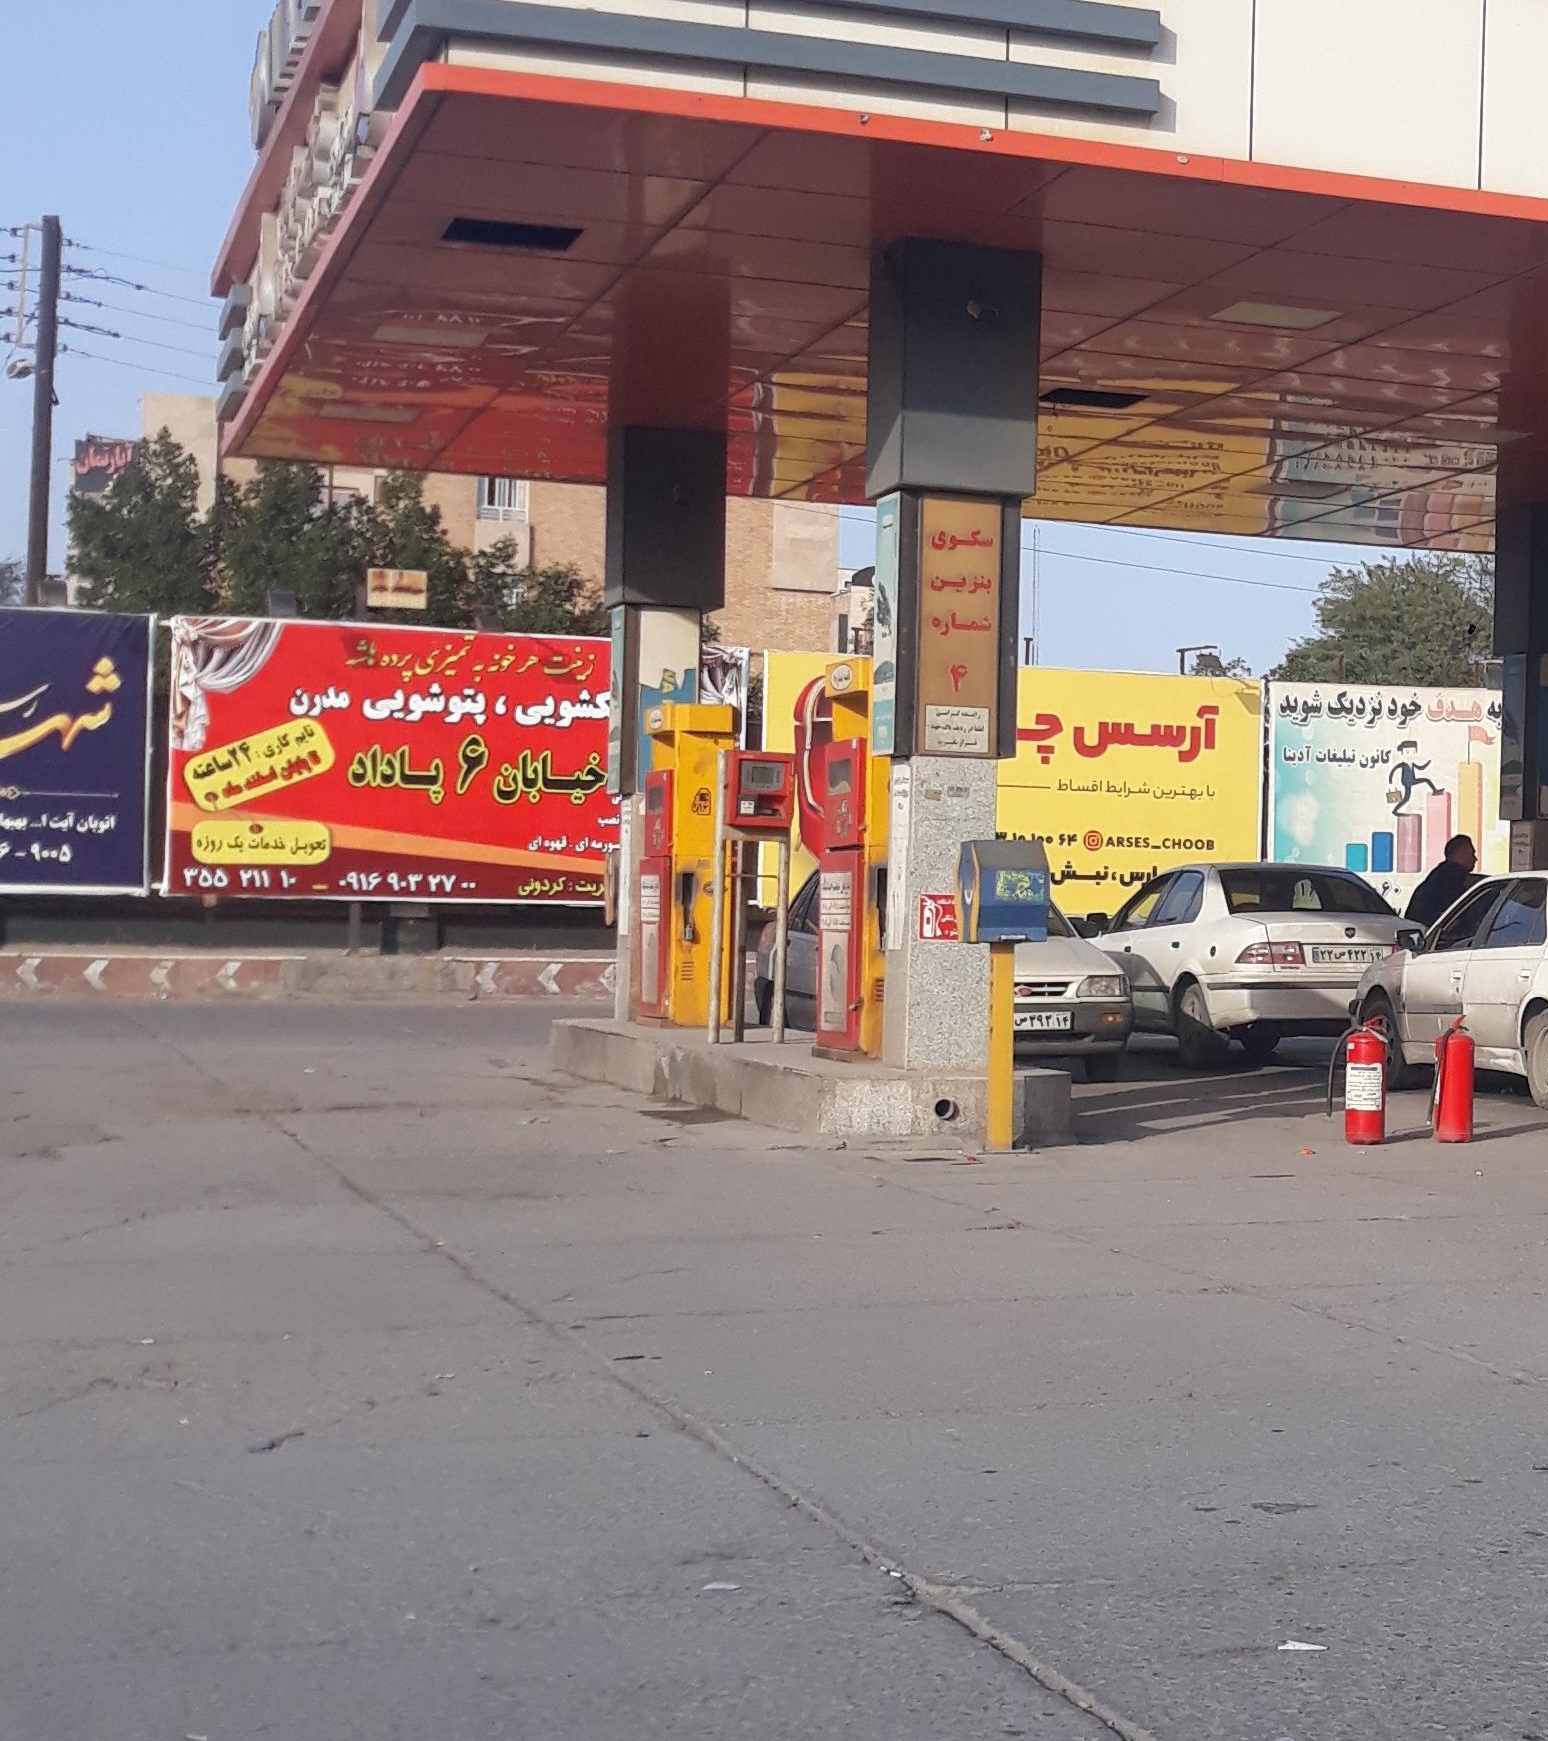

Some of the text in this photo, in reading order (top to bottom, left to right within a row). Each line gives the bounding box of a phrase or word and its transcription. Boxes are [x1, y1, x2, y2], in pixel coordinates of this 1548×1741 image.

[930, 573, 992, 595] بنزین
[931, 612, 992, 636] شماره
[380, 651, 412, 682] پرده
[414, 634, 475, 677] تمیزی
[488, 644, 516, 672] خونه
[516, 657, 539, 673] هر
[543, 646, 595, 682] زینت
[472, 663, 486, 682] به
[949, 663, 968, 693] ۴
[289, 687, 350, 716] مدرن
[515, 689, 611, 727] کشویی
[1280, 690, 1322, 723] شوید
[1328, 691, 1383, 726] نزدیک
[1388, 693, 1421, 725] خود
[1427, 693, 1483, 721] هدف
[263, 733, 290, 758] کاری
[294, 724, 315, 747] تایم
[1073, 705, 1219, 763] آرسس
[348, 734, 608, 803] خیابان ۶ پاداد
[1283, 745, 1391, 768] کانون تبلیغات آدینا
[1057, 778, 1216, 801] با بهترین شرایط اقساط
[0, 813, 27, 831] بهبها
[49, 812, 75, 830] آیت
[77, 814, 116, 833] اتوبان
[31, 843, 71, 862] ۹۰۰۵
[197, 835, 327, 856] تحویل خدمات یک روزه
[544, 836, 567, 852] قهوه
[1105, 836, 1215, 851] ARSES_CHOOB
[183, 867, 228, 888] ۳۵۵
[239, 869, 270, 889] ۲۱۱
[339, 872, 381, 891] ۰۹۱۶
[387, 873, 423, 891] ۹۰۳
[428, 874, 456, 893] ۲۷
[1050, 860, 1109, 886] نبش
[575, 879, 605, 896] ریت
